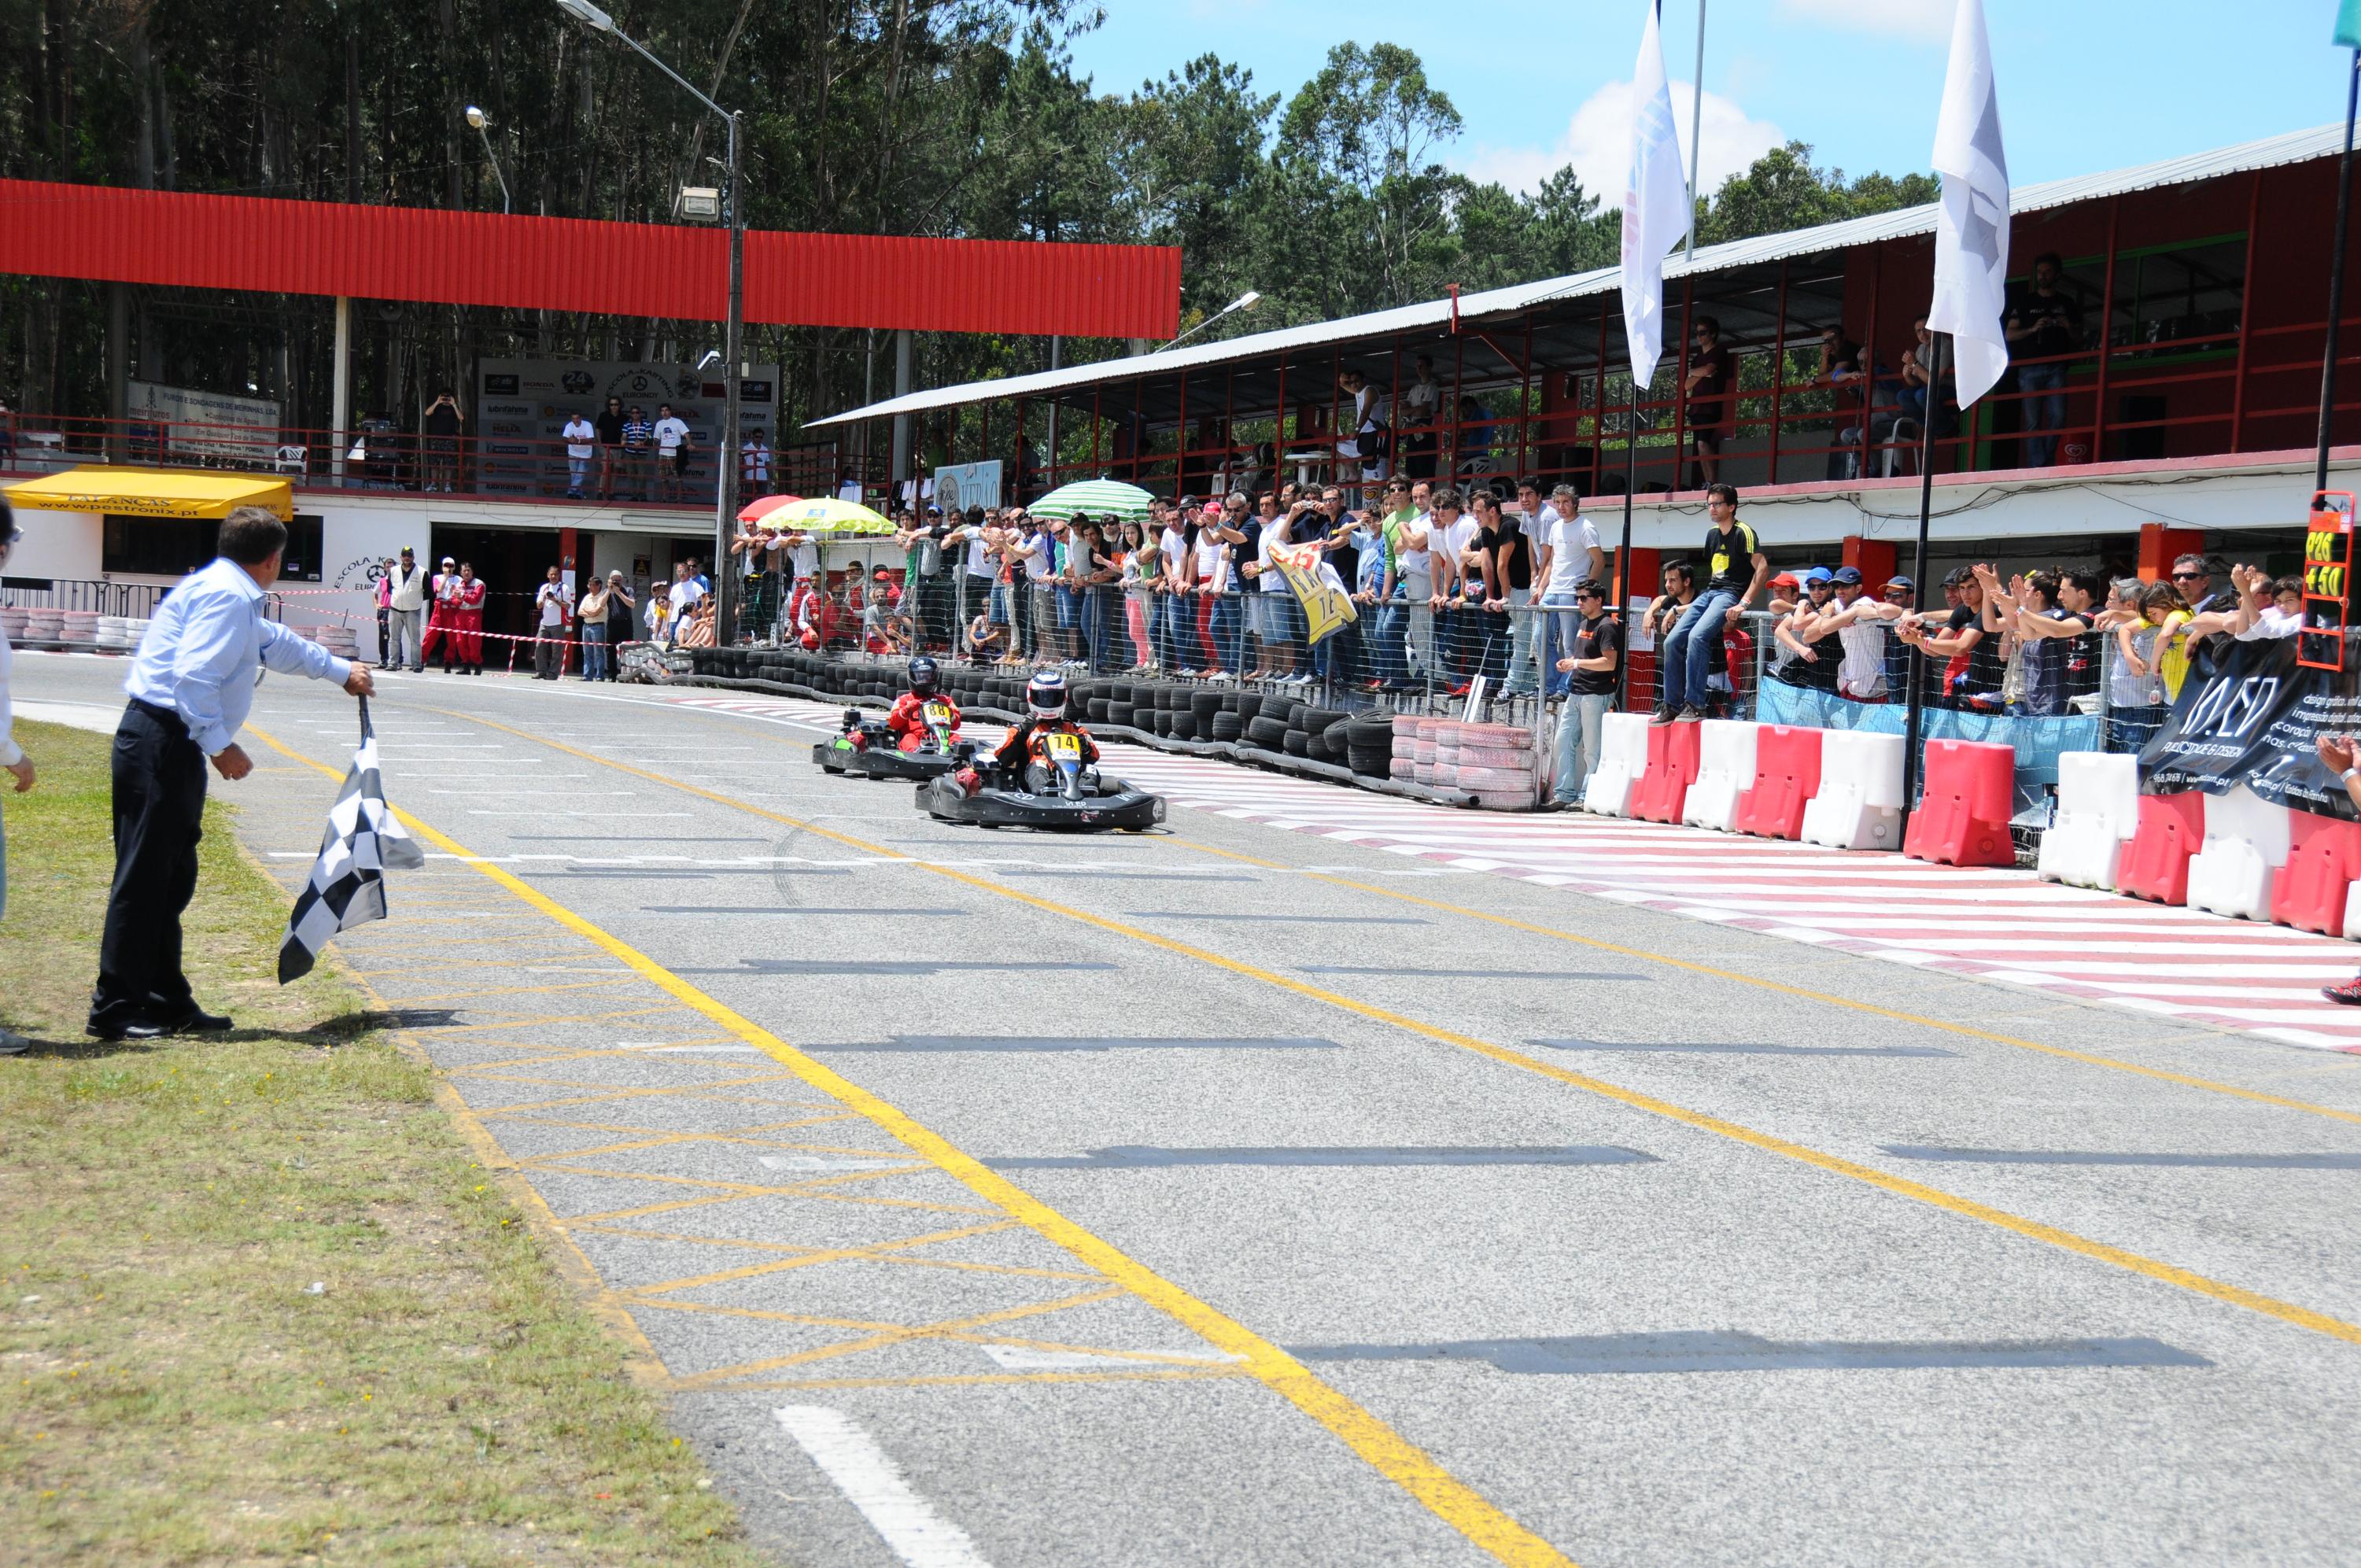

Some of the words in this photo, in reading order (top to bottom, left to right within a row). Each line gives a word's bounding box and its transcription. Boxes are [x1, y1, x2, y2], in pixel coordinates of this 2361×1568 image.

[640, 368, 674, 398] KARTING
[164, 393, 184, 403] FUROS
[189, 397, 225, 409] SONDAGENS
[39, 502, 200, 517] www.pestronix.pt
[2306, 531, 2333, 563] P26
[334, 556, 371, 588] ESCOLA
[929, 704, 946, 716] 88
